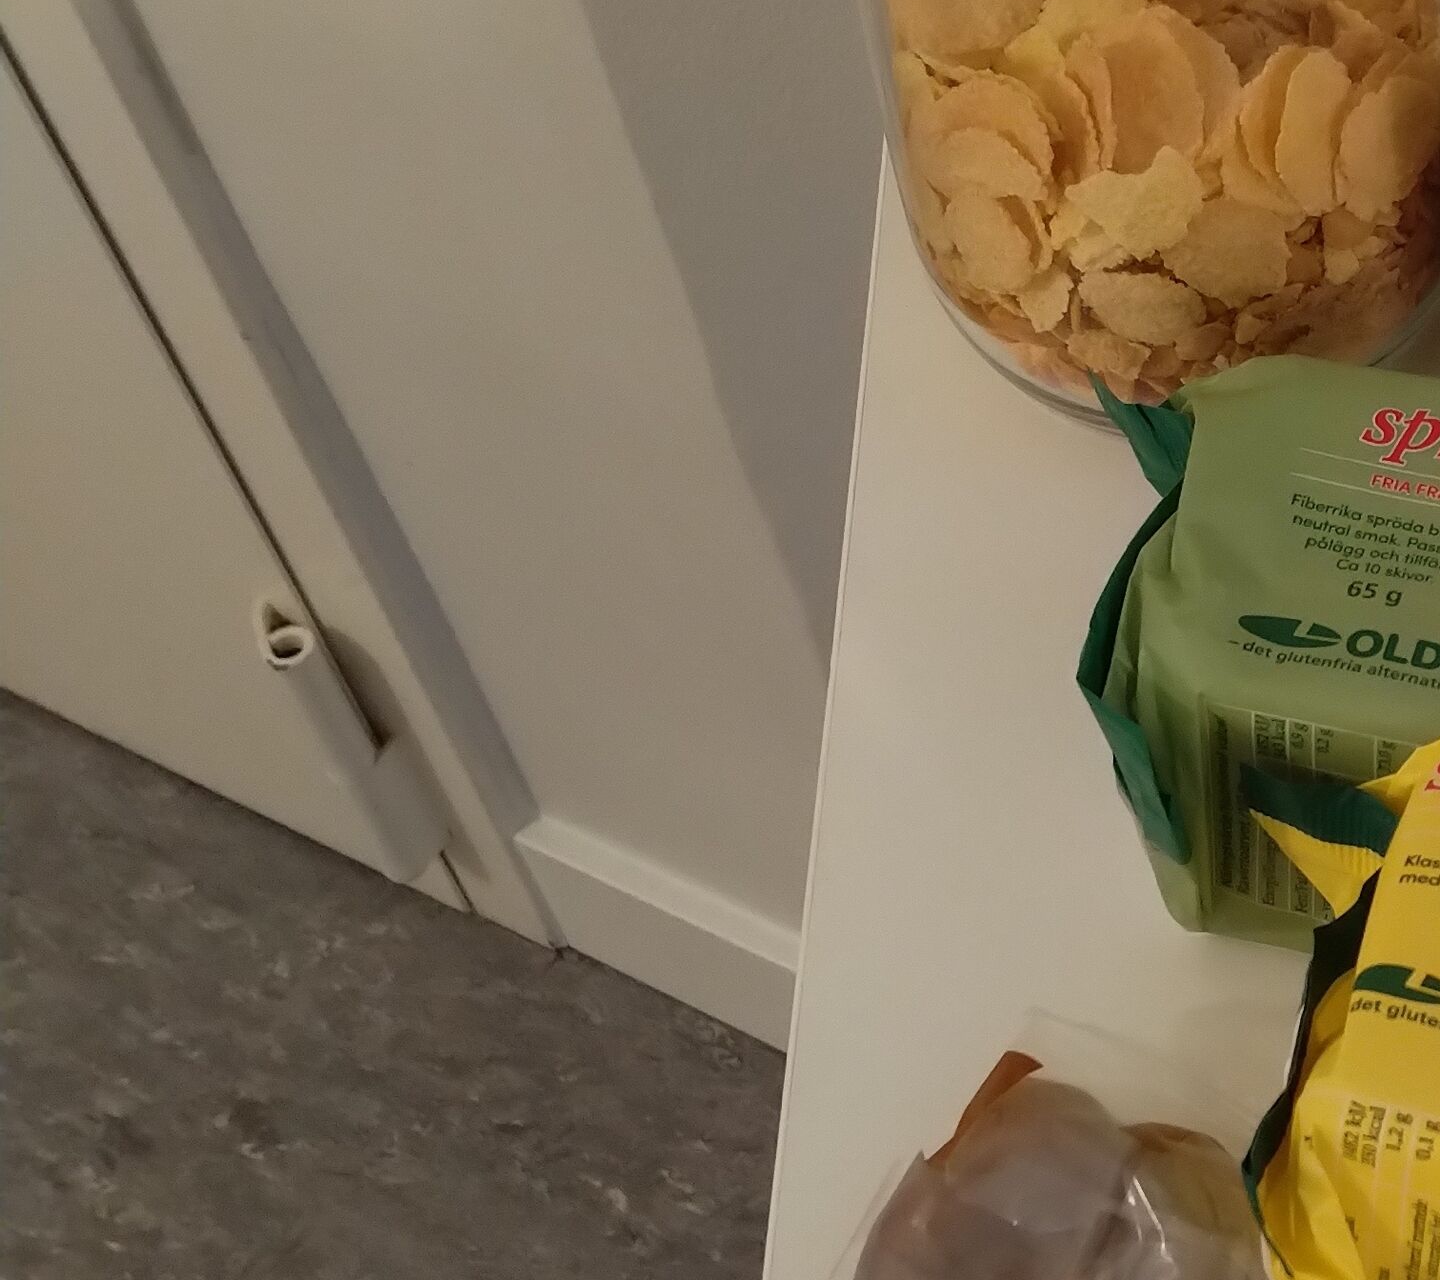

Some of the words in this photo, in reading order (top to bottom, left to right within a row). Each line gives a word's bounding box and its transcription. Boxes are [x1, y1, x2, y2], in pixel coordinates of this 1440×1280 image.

[1370, 473, 1411, 495] FRIA
[1291, 493, 1362, 521] Fiberrika
[1367, 512, 1425, 535] spröda
[1292, 514, 1350, 537] neutral
[1305, 536, 1365, 560] pålägg
[1369, 548, 1400, 562] och
[1336, 558, 1359, 572] Ca
[1364, 562, 1381, 575] 10
[1347, 580, 1379, 599] 65
[1385, 589, 1403, 607] g
[1242, 640, 1273, 659] det
[1275, 645, 1363, 674] glutenfria
